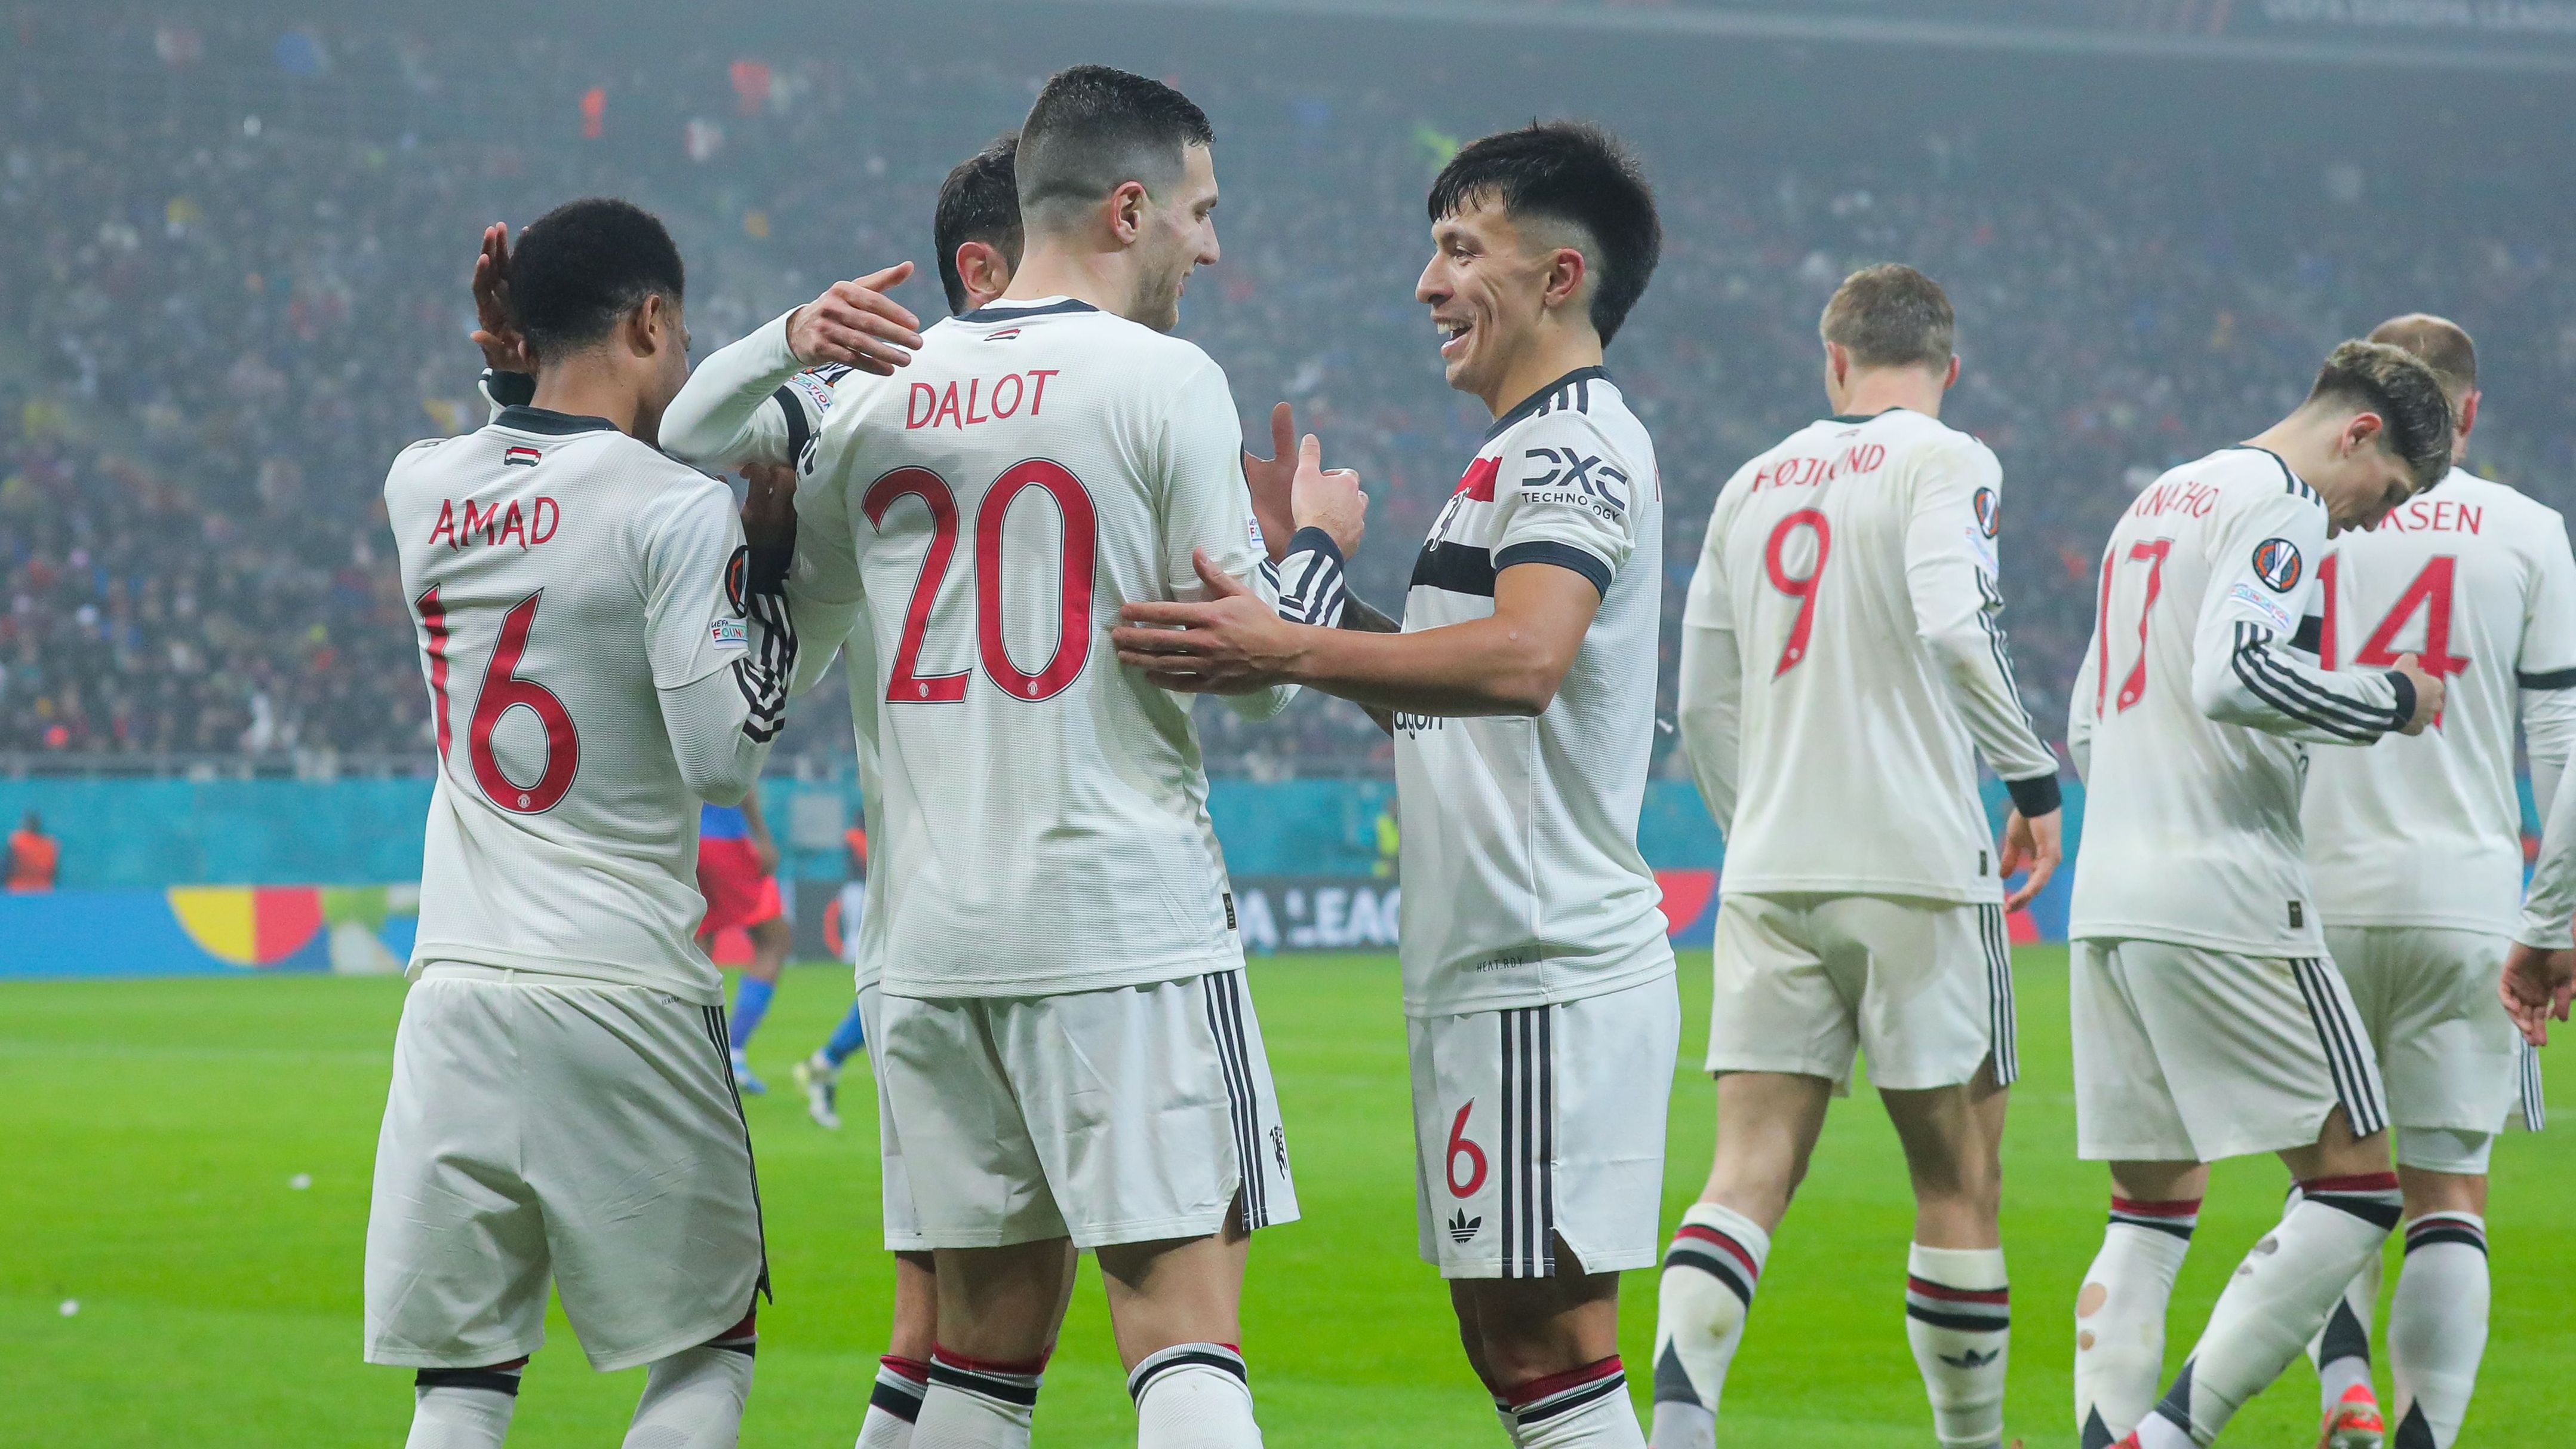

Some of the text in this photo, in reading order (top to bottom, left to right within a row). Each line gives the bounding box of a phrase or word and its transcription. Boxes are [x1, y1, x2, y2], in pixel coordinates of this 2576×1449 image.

[905, 370, 1060, 431] DALOT
[1522, 447, 1627, 511] DXC
[1522, 492, 1620, 523] TECHNOOGY
[1752, 444, 1885, 493] HØJLND
[428, 497, 560, 552] AMAD
[861, 457, 1099, 704] 20
[1764, 506, 1831, 685] 9
[711, 619, 728, 628] UEFA
[2096, 536, 2175, 724] 17
[2316, 548, 2473, 736] 14
[415, 583, 580, 815] 16
[1446, 1097, 1487, 1199] 6
